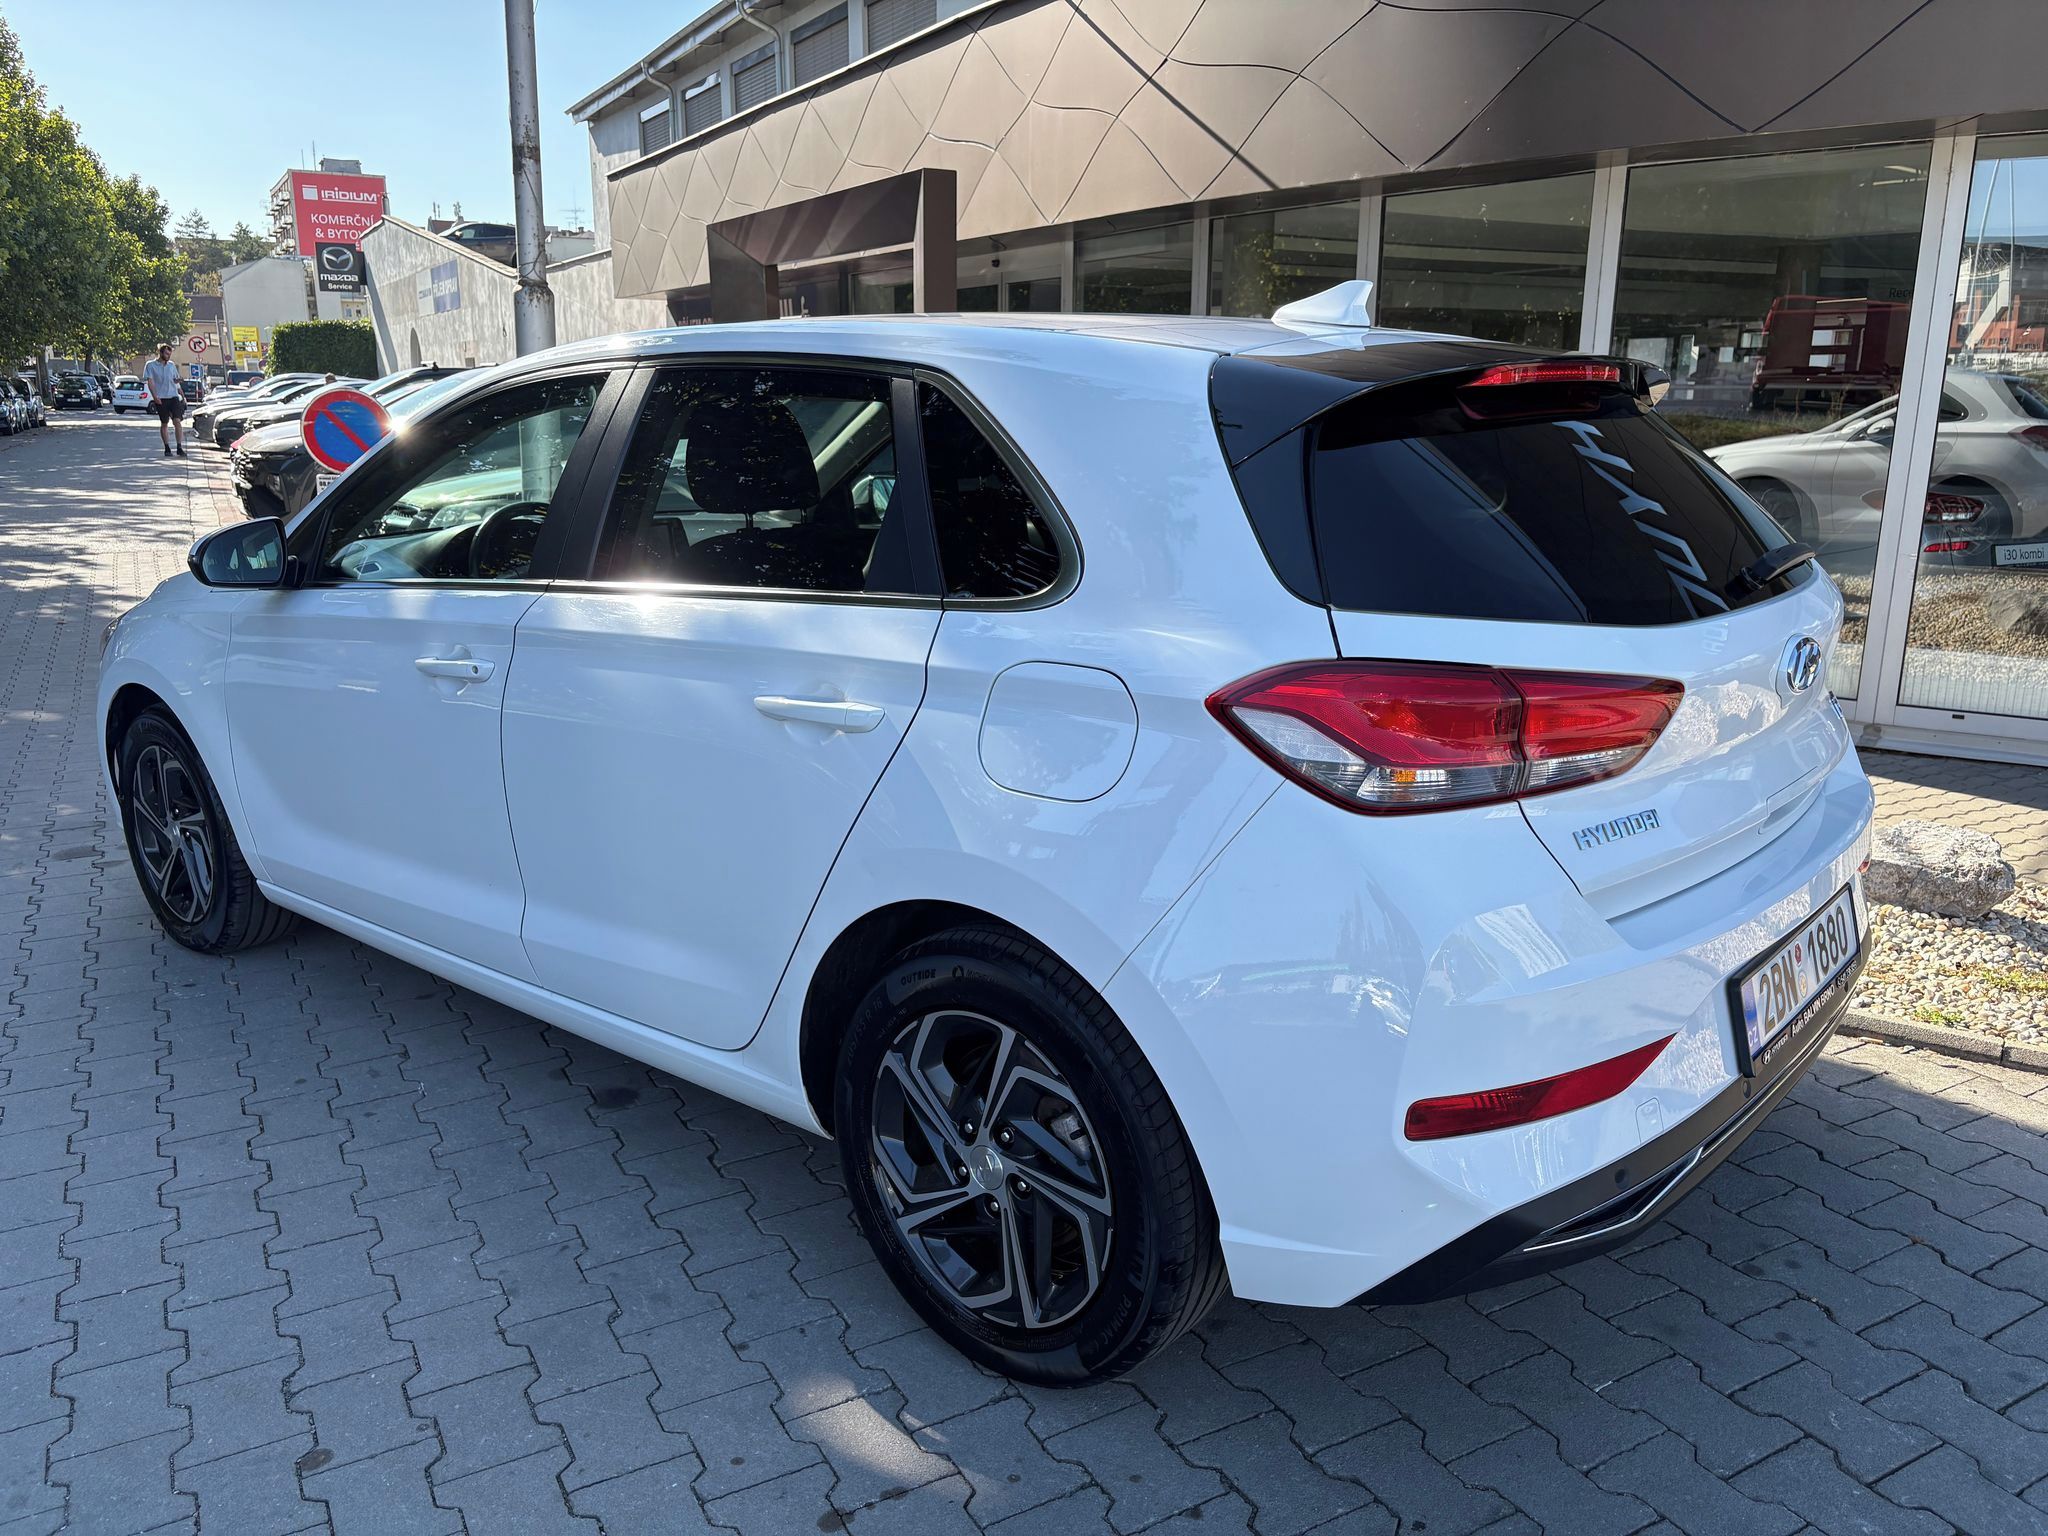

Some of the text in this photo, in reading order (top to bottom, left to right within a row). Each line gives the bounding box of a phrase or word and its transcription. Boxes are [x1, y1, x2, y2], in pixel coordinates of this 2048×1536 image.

[315, 229, 324, 239] &
[327, 283, 353, 291] Service
[2003, 547, 2046, 561] i30 kombi
[1571, 808, 1662, 851] HYUNDAI
[899, 968, 937, 986] OUTSIDE
[1759, 905, 1849, 1036] 2BN 1880
[1747, 1026, 1759, 1048] CZ
